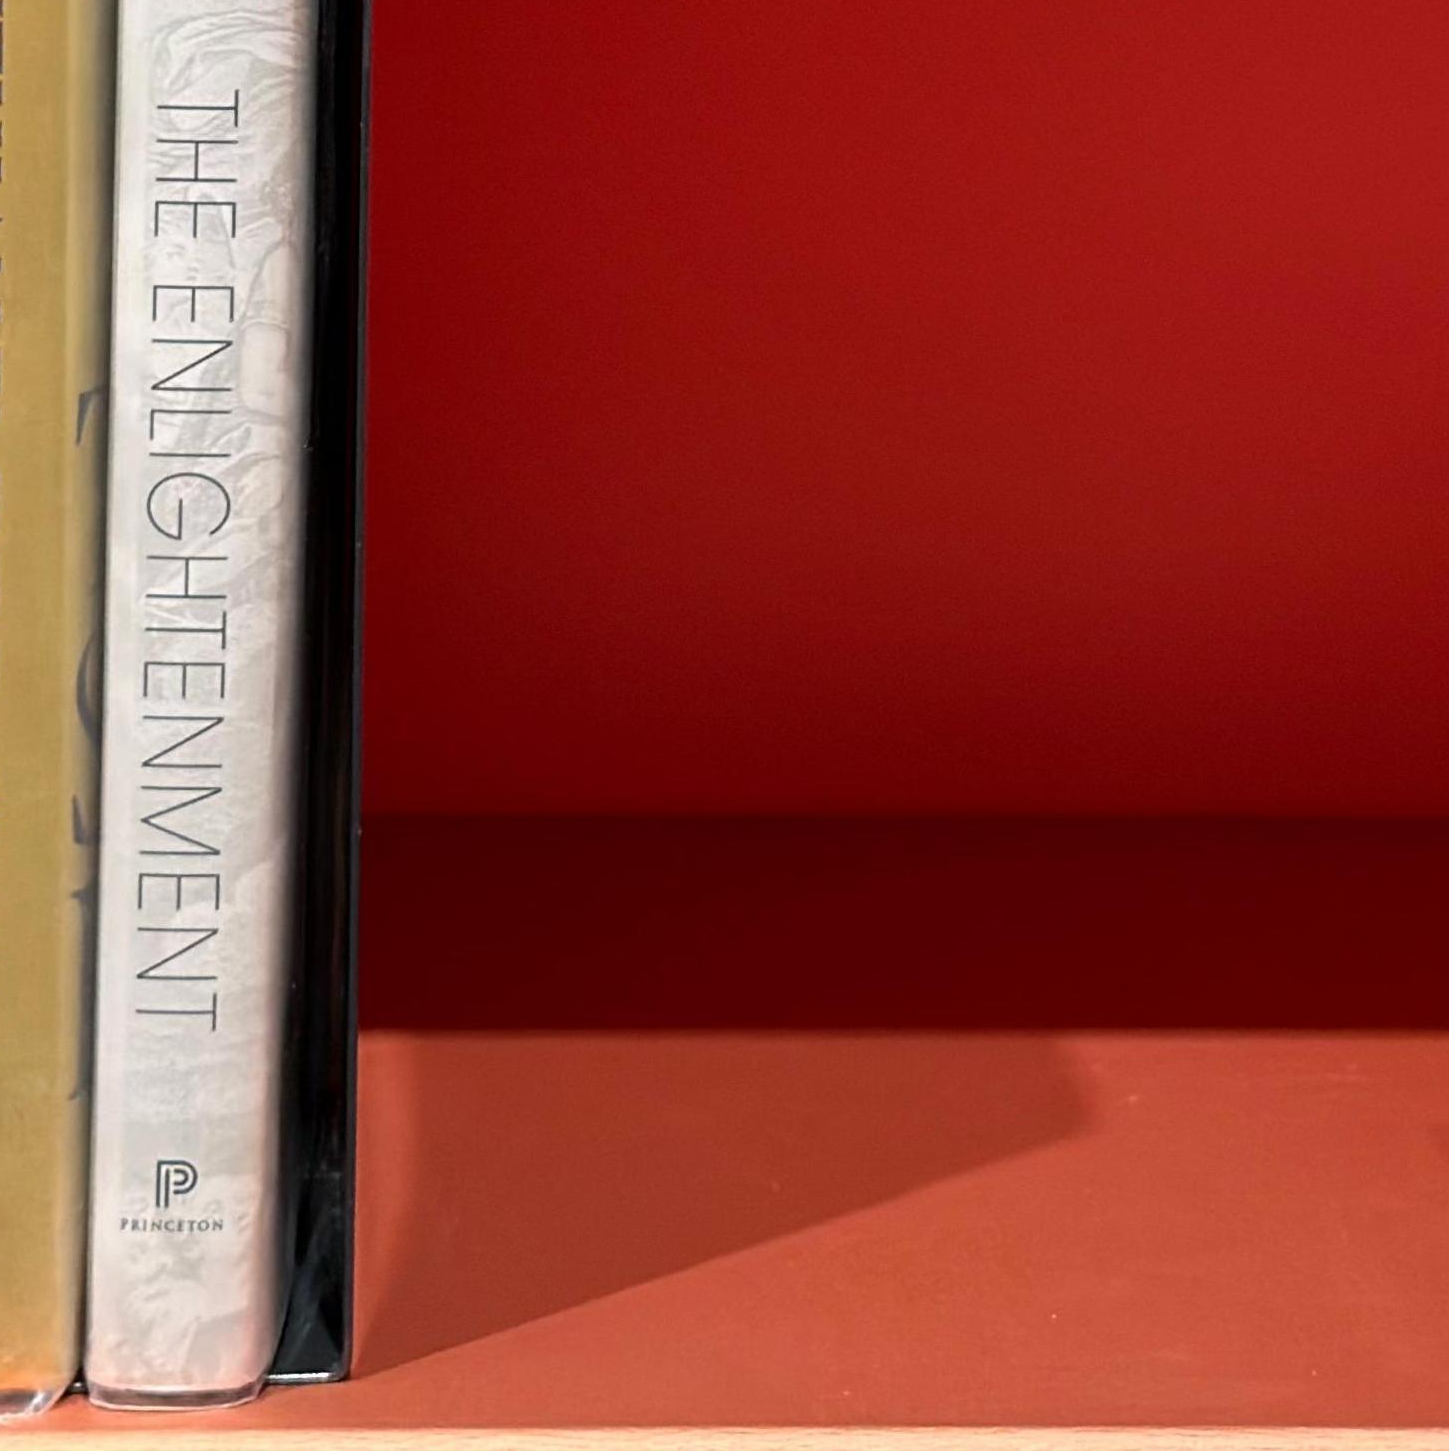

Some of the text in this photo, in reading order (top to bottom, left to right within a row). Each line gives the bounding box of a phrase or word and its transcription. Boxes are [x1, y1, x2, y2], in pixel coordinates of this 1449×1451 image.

[135, 88, 241, 1032] THE ENLIGHTENMENT
[120, 1217, 224, 1231] PRINCETON
